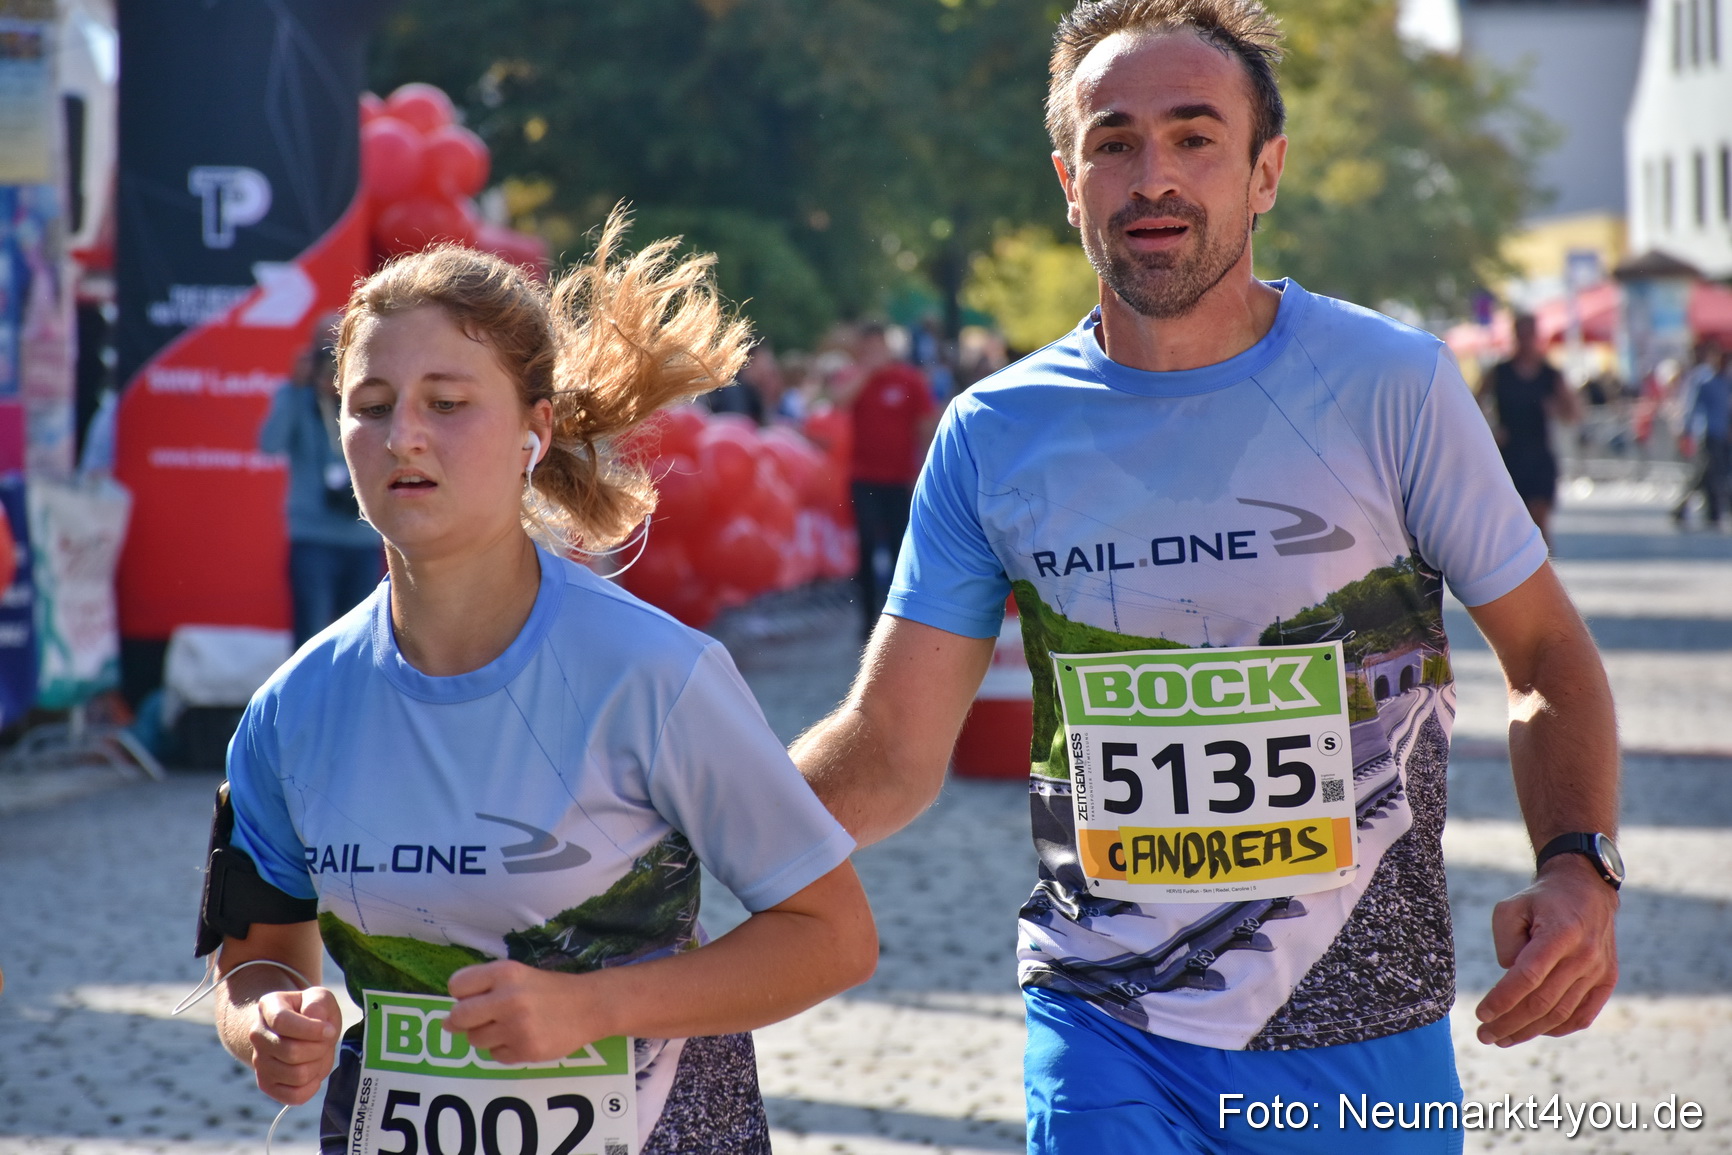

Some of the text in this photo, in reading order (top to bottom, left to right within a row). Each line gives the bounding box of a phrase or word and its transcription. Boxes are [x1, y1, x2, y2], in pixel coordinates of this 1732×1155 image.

[1032, 530, 1258, 578] RAIL.ONE
[1078, 658, 1318, 715] BOCK
[1323, 736, 1337, 751] S
[1101, 734, 1317, 815] 5135
[1131, 826, 1328, 880] ANDREAS
[381, 1006, 606, 1069] BO
[377, 1089, 595, 1155] 5002
[608, 1098, 621, 1113] S
